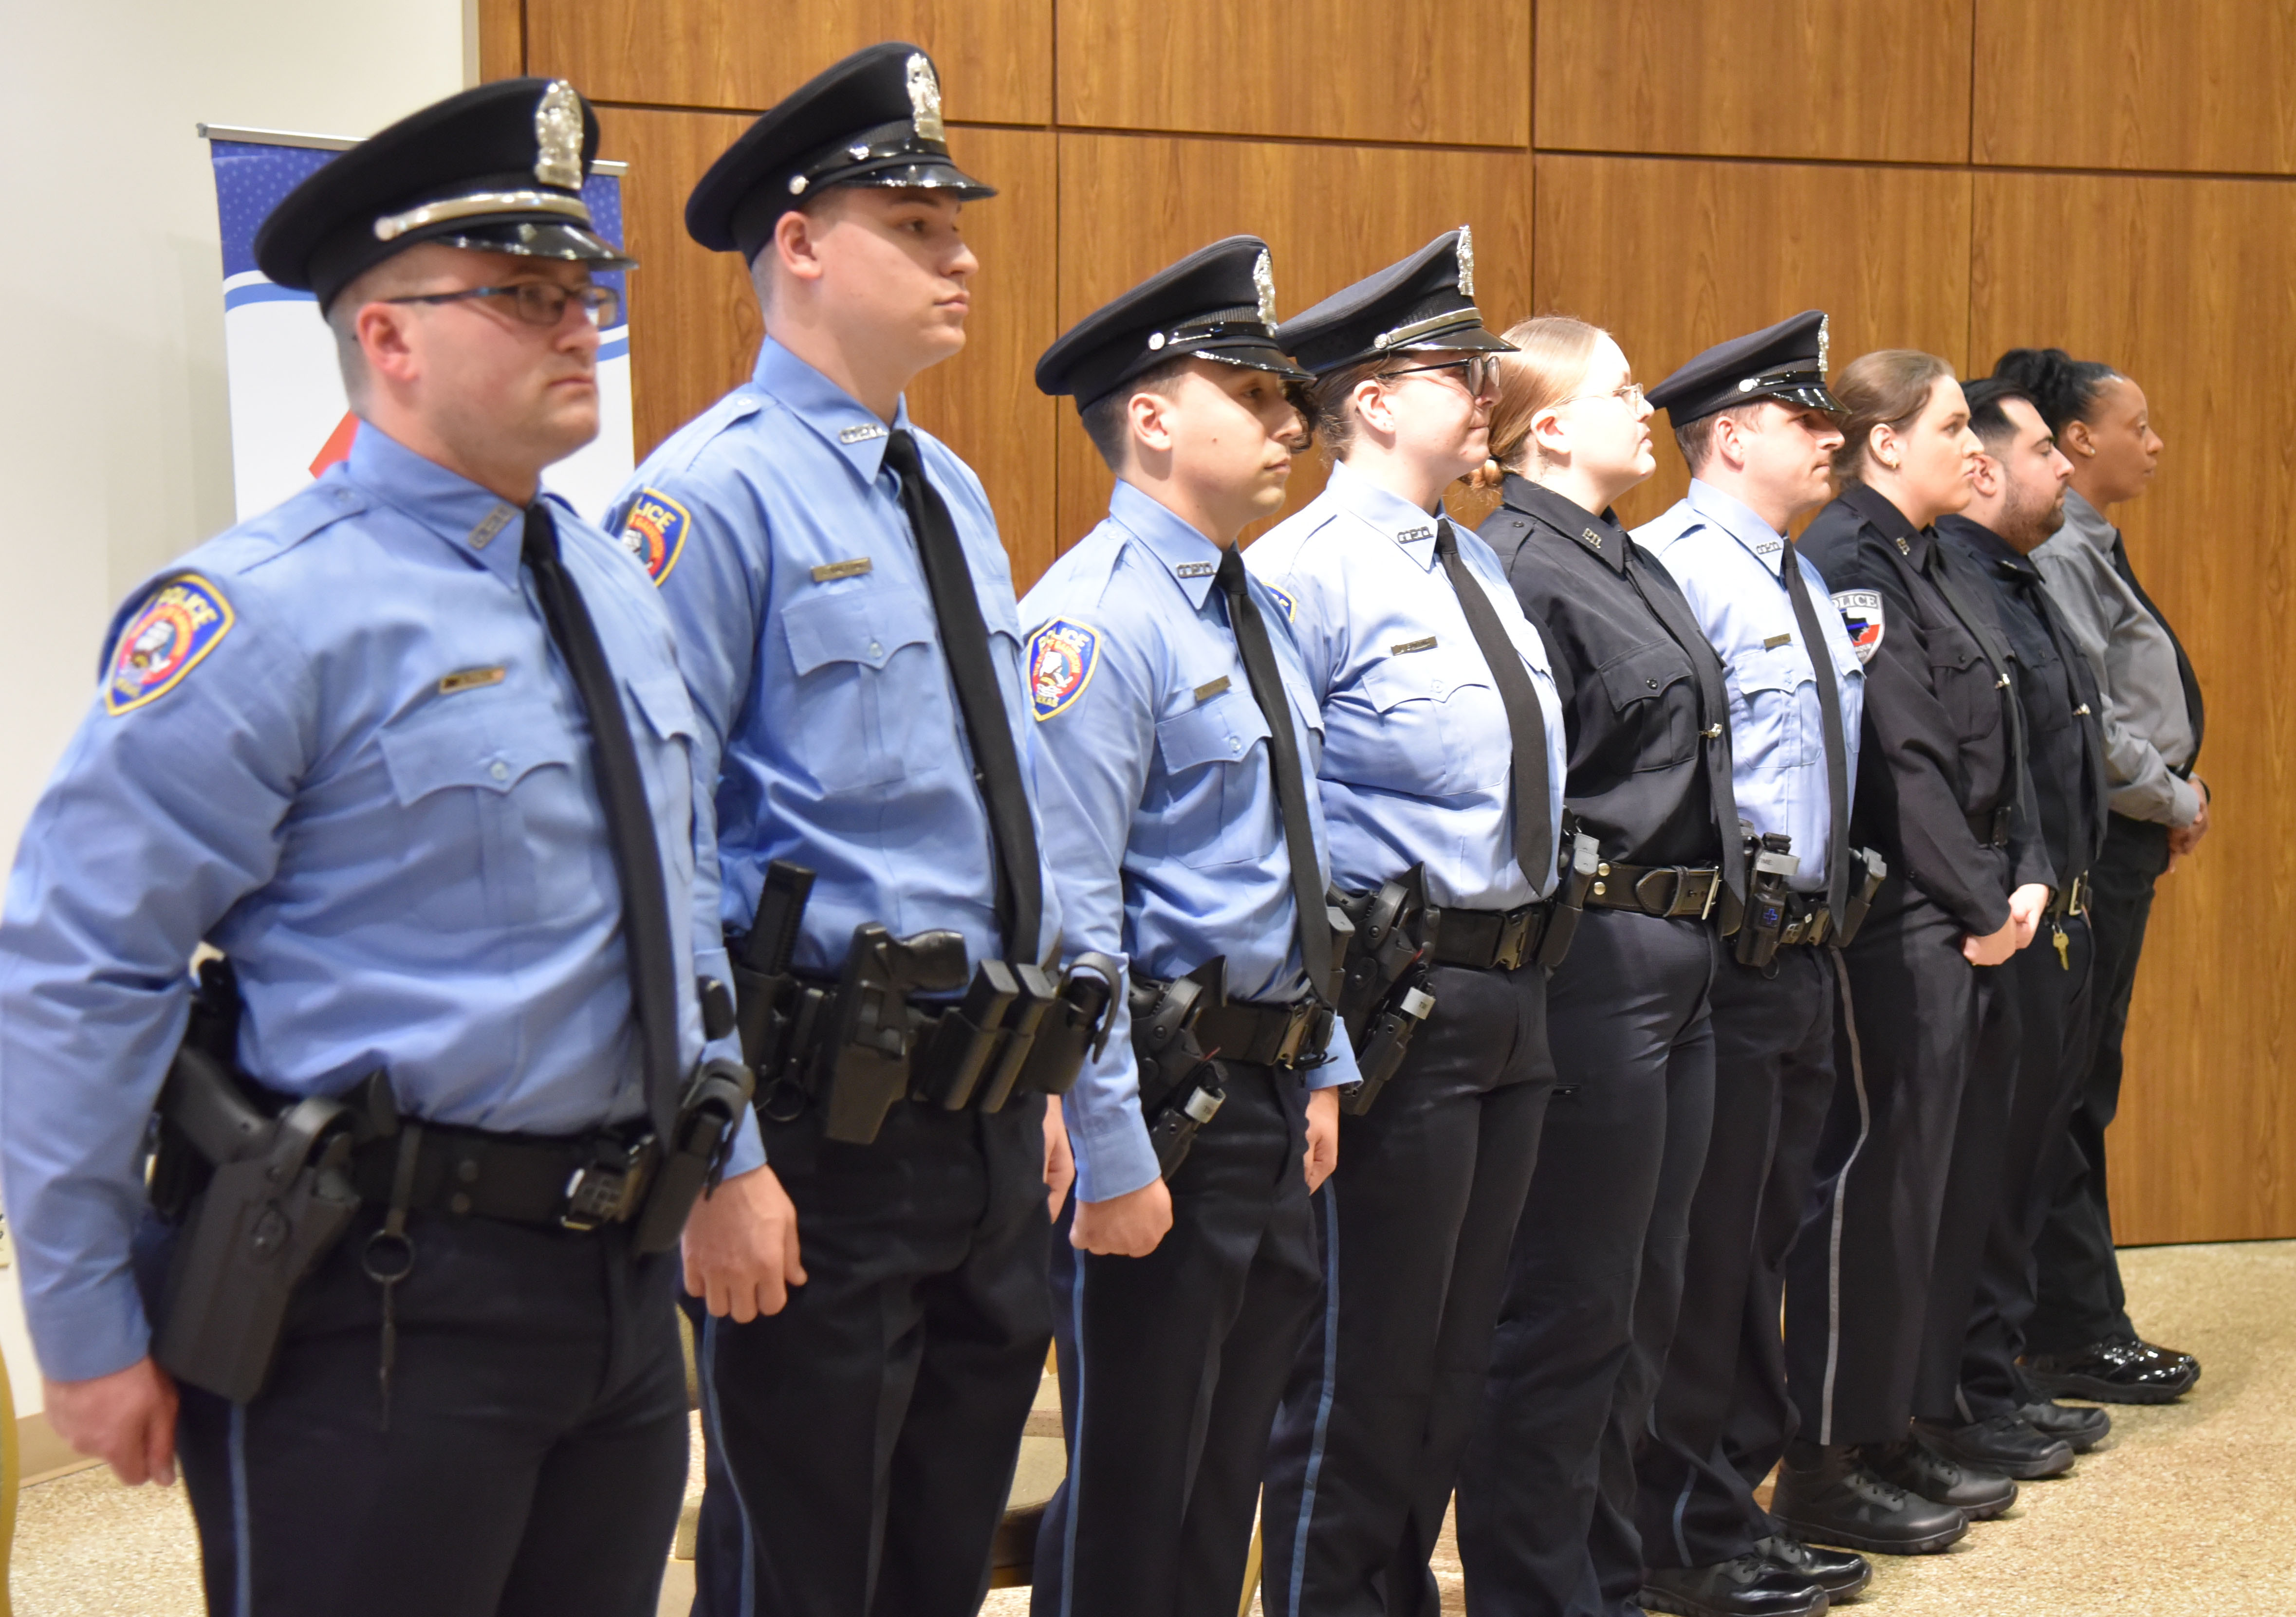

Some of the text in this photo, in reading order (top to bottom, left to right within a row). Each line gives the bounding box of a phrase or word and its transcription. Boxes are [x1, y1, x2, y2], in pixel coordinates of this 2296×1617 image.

[635, 496, 677, 533] LICE
[1832, 595, 1877, 608] OLICE
[1037, 627, 1090, 653] POLICE
